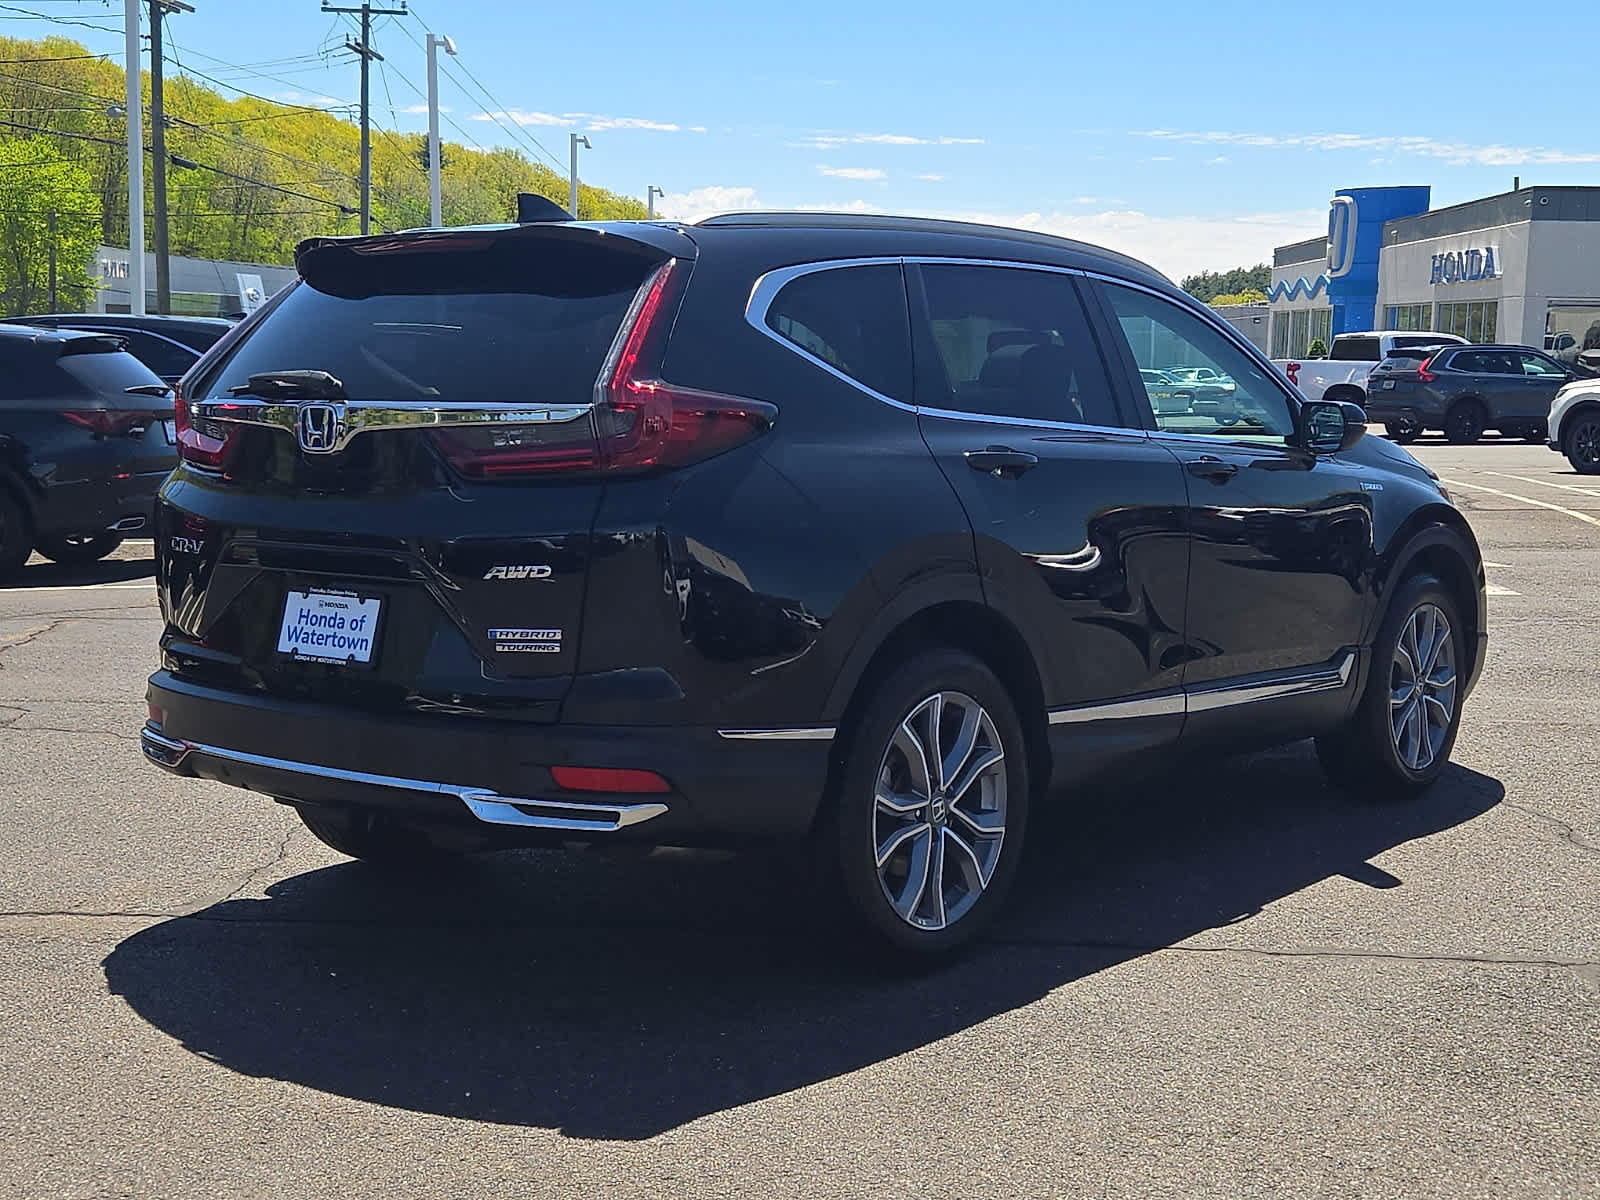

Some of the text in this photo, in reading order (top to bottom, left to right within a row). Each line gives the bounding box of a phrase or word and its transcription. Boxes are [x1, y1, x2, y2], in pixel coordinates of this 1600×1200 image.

[1430, 246, 1501, 285] HONDA
[482, 564, 552, 580] AWD
[298, 607, 367, 633] Honda of
[287, 624, 369, 652] Watertown
[499, 631, 557, 639] HYBRID
